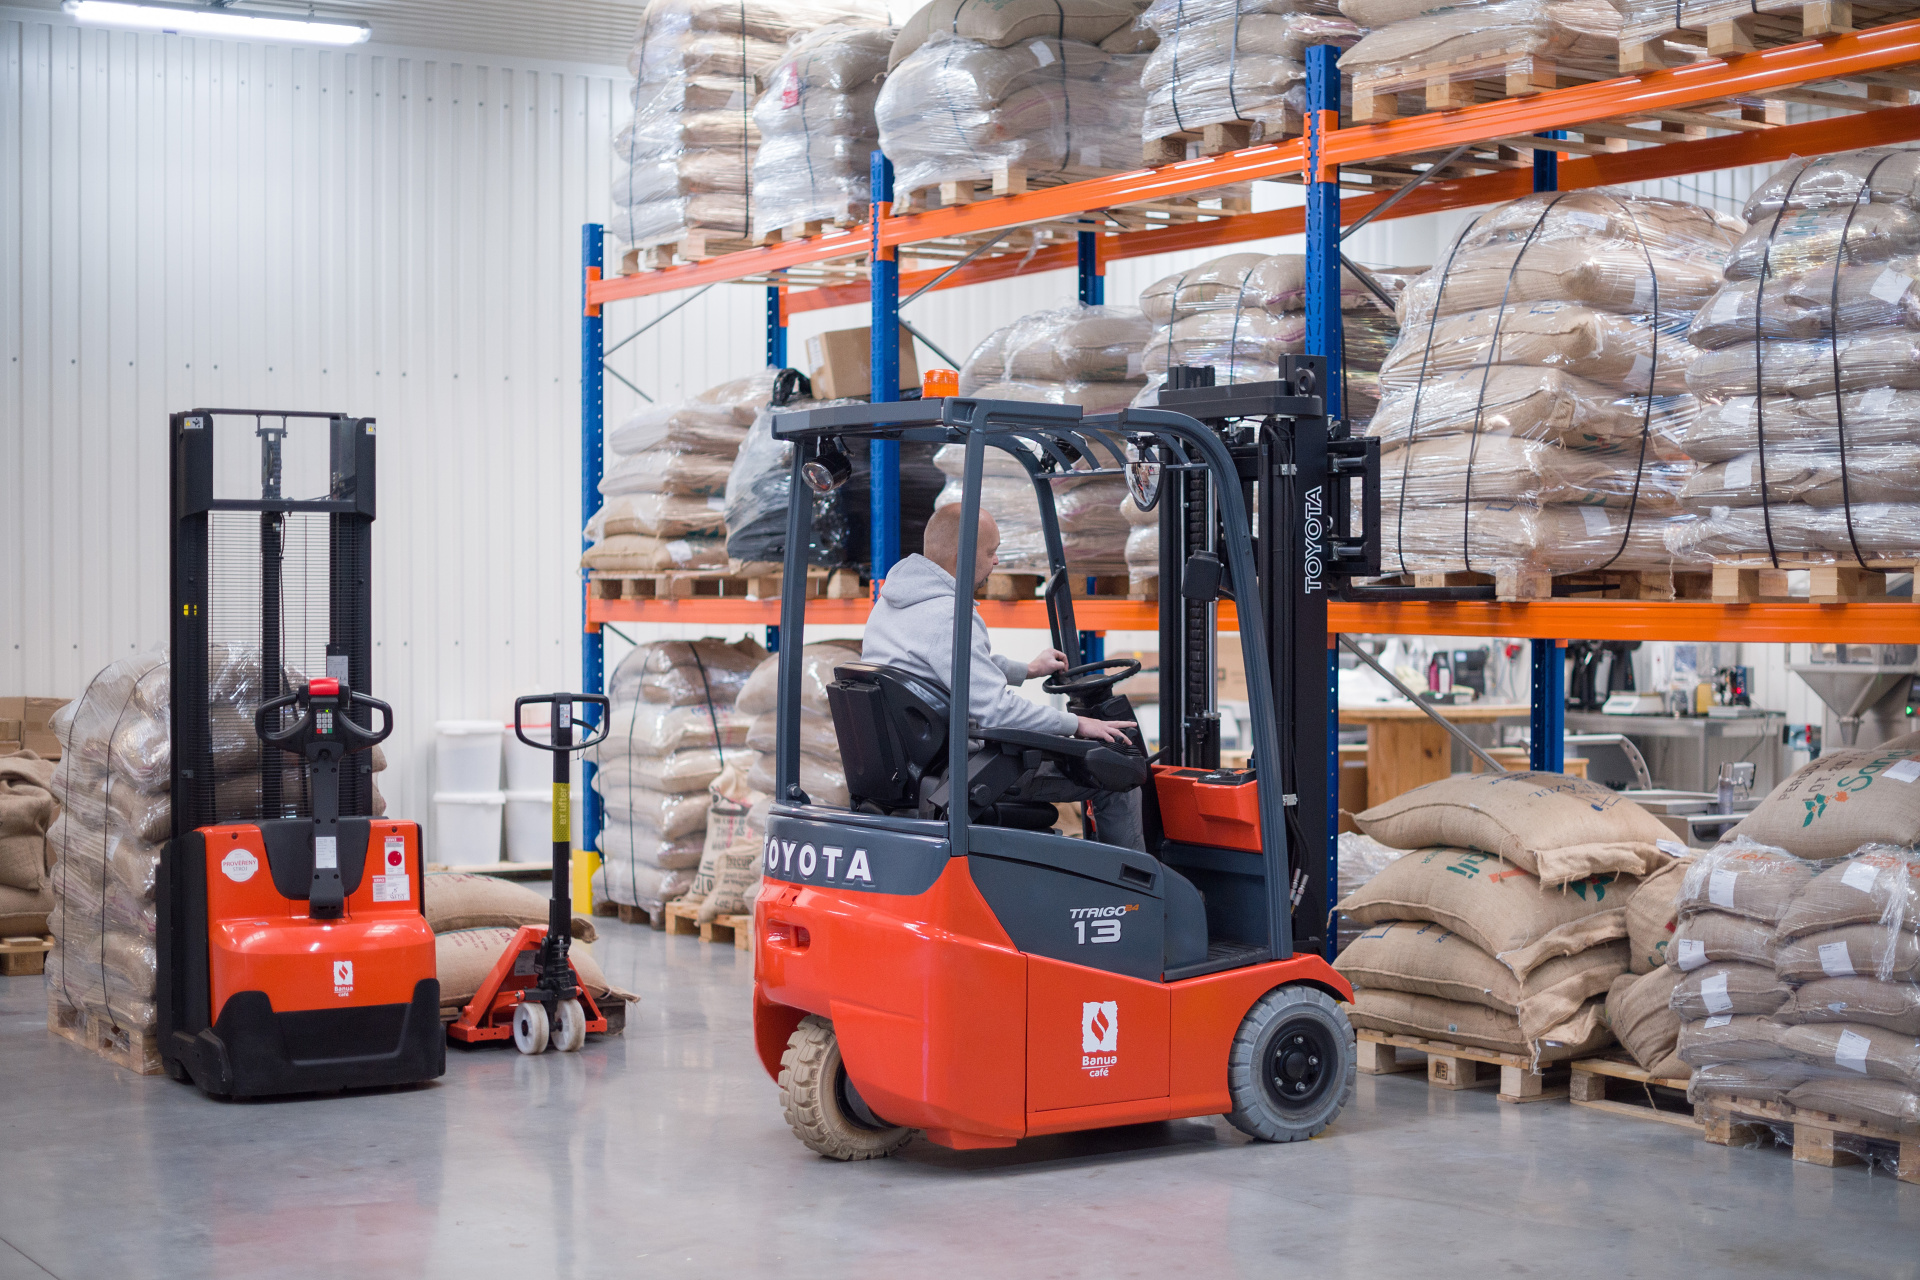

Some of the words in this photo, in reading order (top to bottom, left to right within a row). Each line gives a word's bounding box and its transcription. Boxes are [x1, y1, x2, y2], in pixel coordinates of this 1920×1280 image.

[1304, 485, 1322, 594] TOYOTA
[1069, 905, 1127, 919] TRAIGO
[1073, 919, 1122, 945] 13
[1082, 1055, 1118, 1066] Banua
[1089, 1067, 1110, 1077] café
